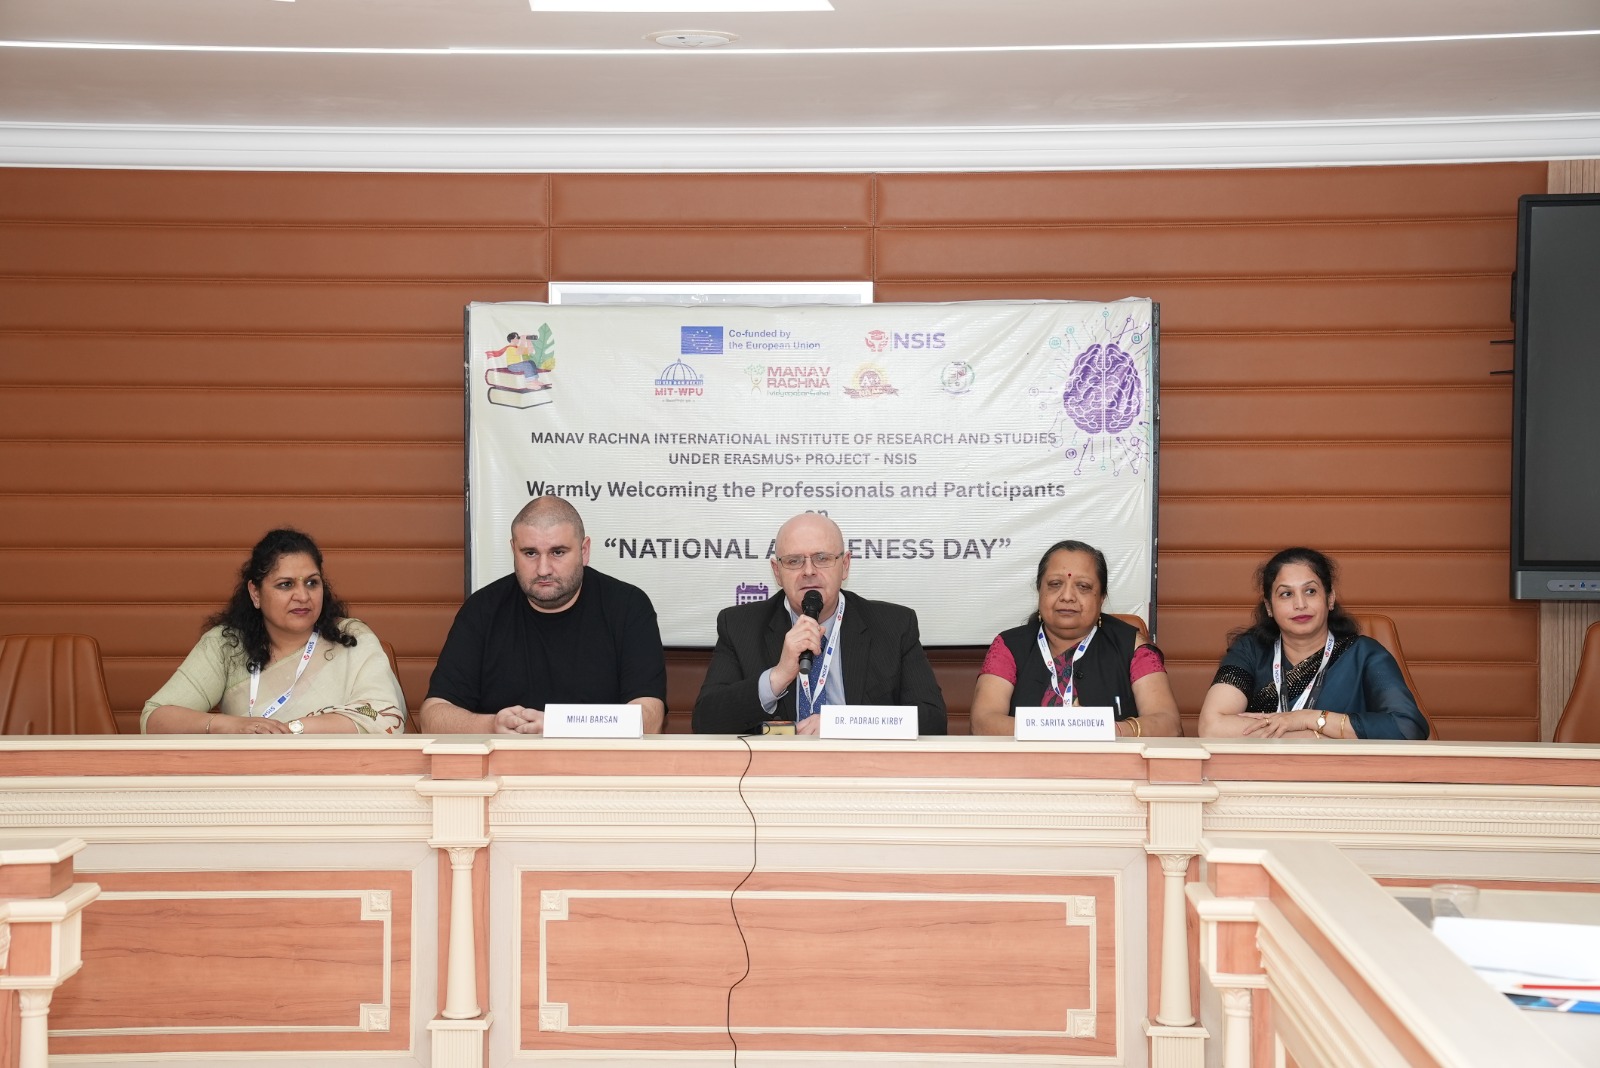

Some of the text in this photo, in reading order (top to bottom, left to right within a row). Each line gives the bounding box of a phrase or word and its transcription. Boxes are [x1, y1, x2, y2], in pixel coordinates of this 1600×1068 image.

[728, 329, 791, 340] Co-funded by
[728, 341, 821, 351] the European Union
[893, 332, 946, 349] NSIS
[767, 366, 831, 377] MANAV
[767, 377, 831, 389] RACHNA
[654, 387, 704, 397] MIT-WPU
[531, 432, 1057, 446] MANAV RACHNA INTERNATIONAL INSTITUTE OF RESEARCH AND STUDIES
[669, 453, 720, 466] UNDER
[723, 453, 802, 466] ERASMUS+
[805, 453, 871, 466] PROJECT
[883, 453, 917, 466] NSIS
[526, 480, 1066, 502] Warmly Welcoming the Professionals and Participants
[604, 537, 1012, 560] “NATIONAL AENESS DAY”
[306, 641, 315, 654] NSIS
[566, 715, 619, 724] MIHAI BARSAN
[834, 716, 904, 726] DR. PADRAIG KIRBY
[1025, 718, 1105, 727] DR. SARITA SACHDEVA
